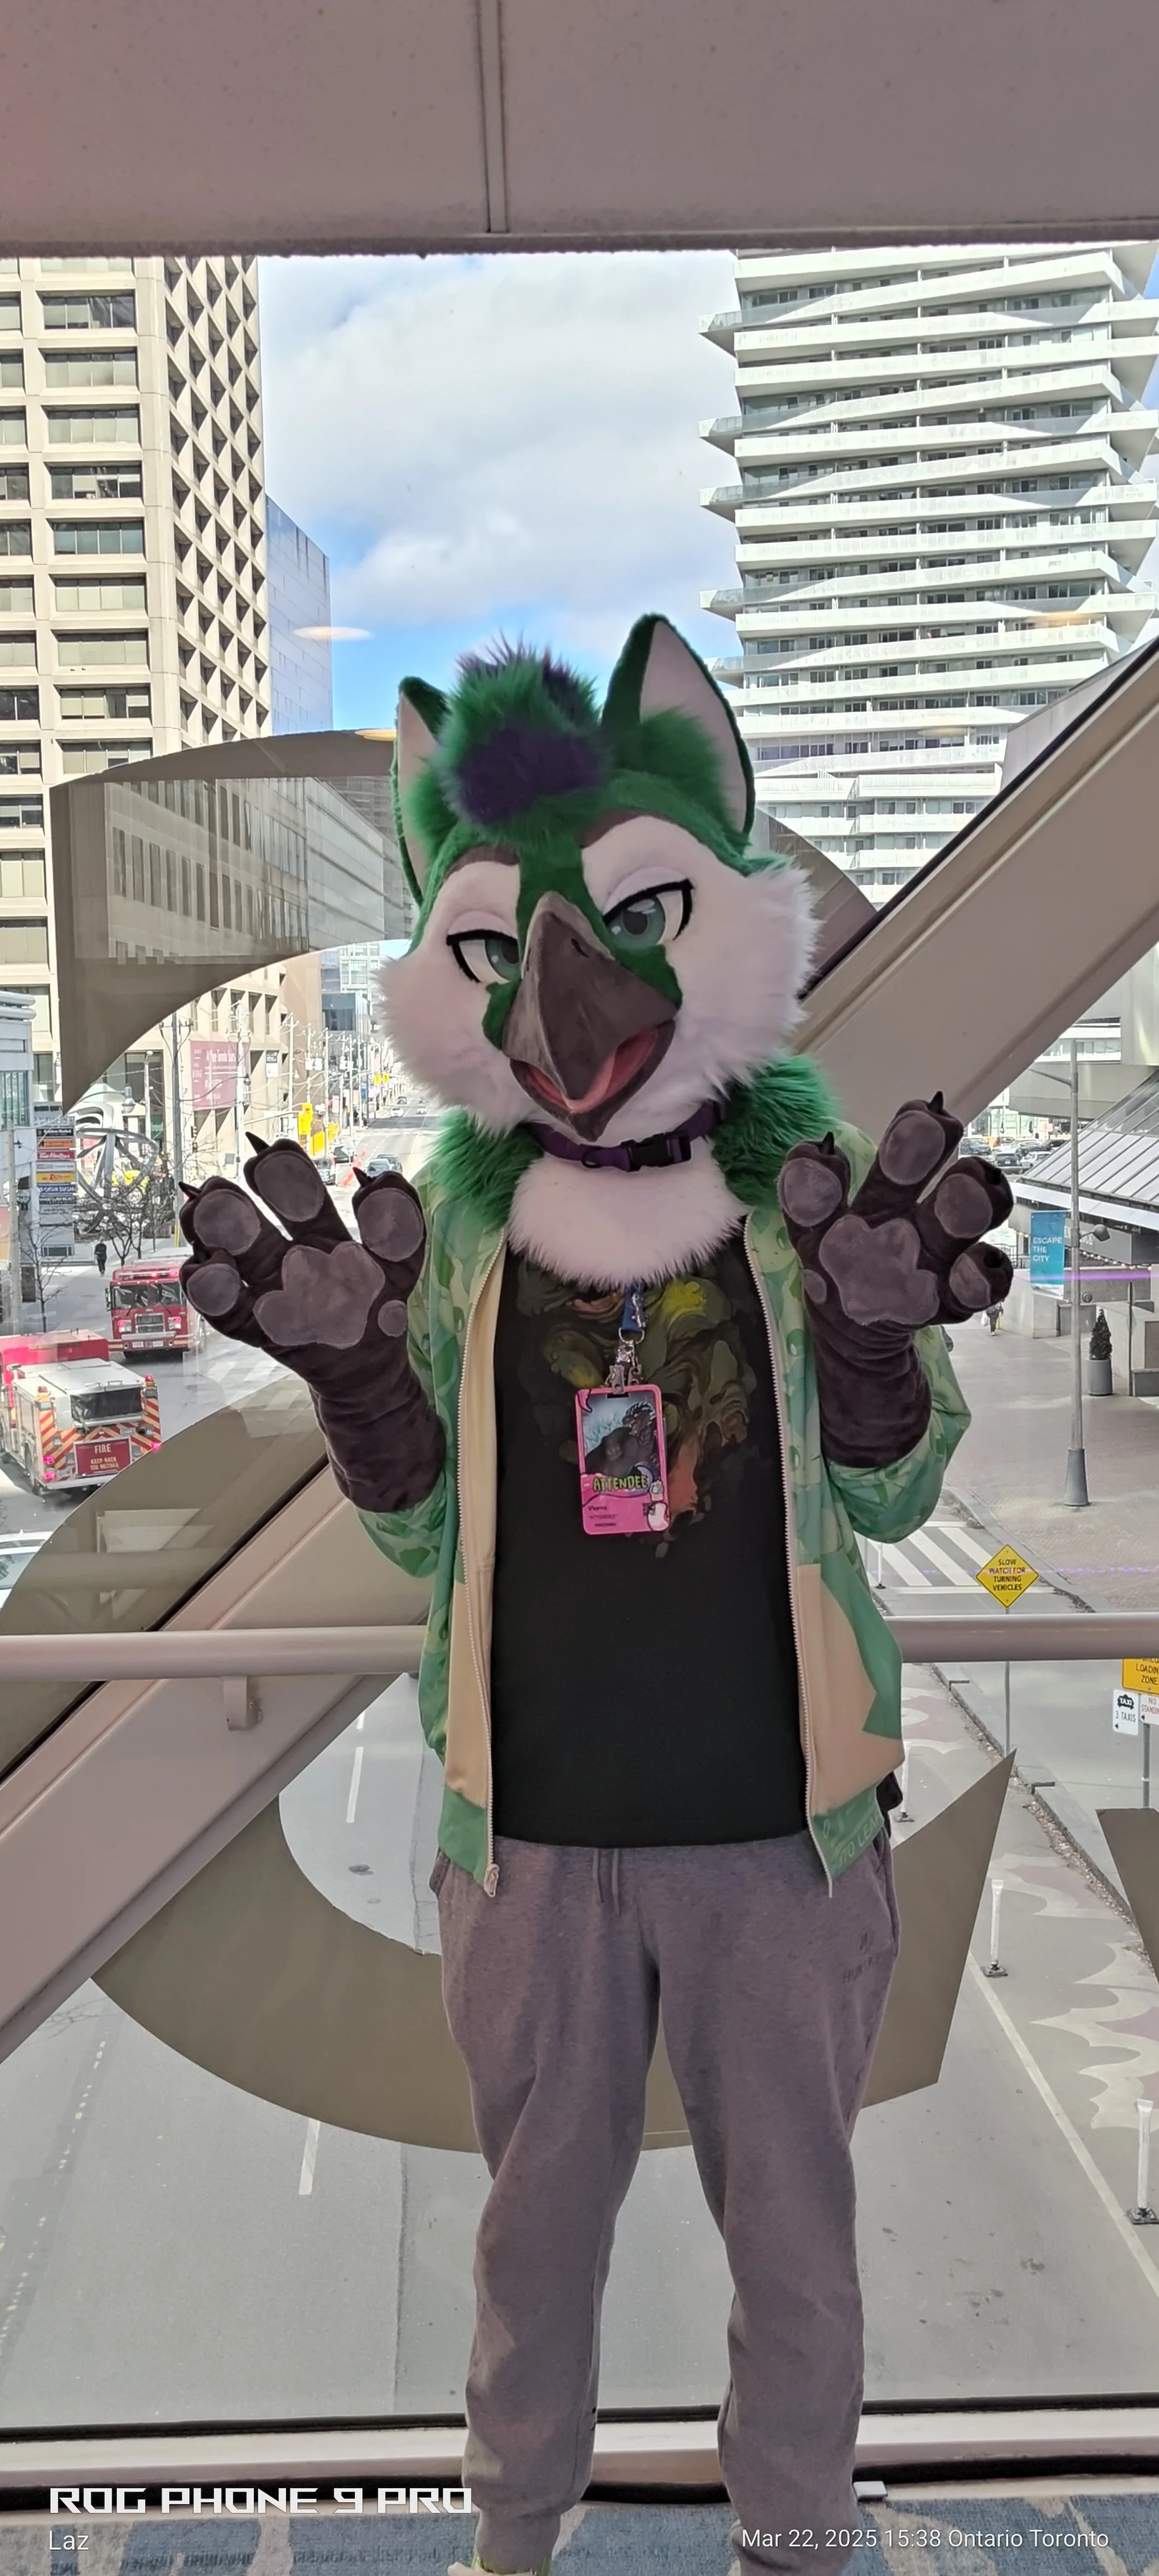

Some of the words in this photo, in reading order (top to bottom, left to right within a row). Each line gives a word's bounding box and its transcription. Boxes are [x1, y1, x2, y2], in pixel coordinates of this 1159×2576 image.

[94, 1443, 111, 1454] FIRE
[593, 1476, 648, 1492] ATTENDEE
[1141, 1674, 1158, 1685] ZONE
[1148, 1696, 1156, 1705] NO
[1115, 1710, 1119, 1719] 3
[1121, 1711, 1136, 1722] TAXIS
